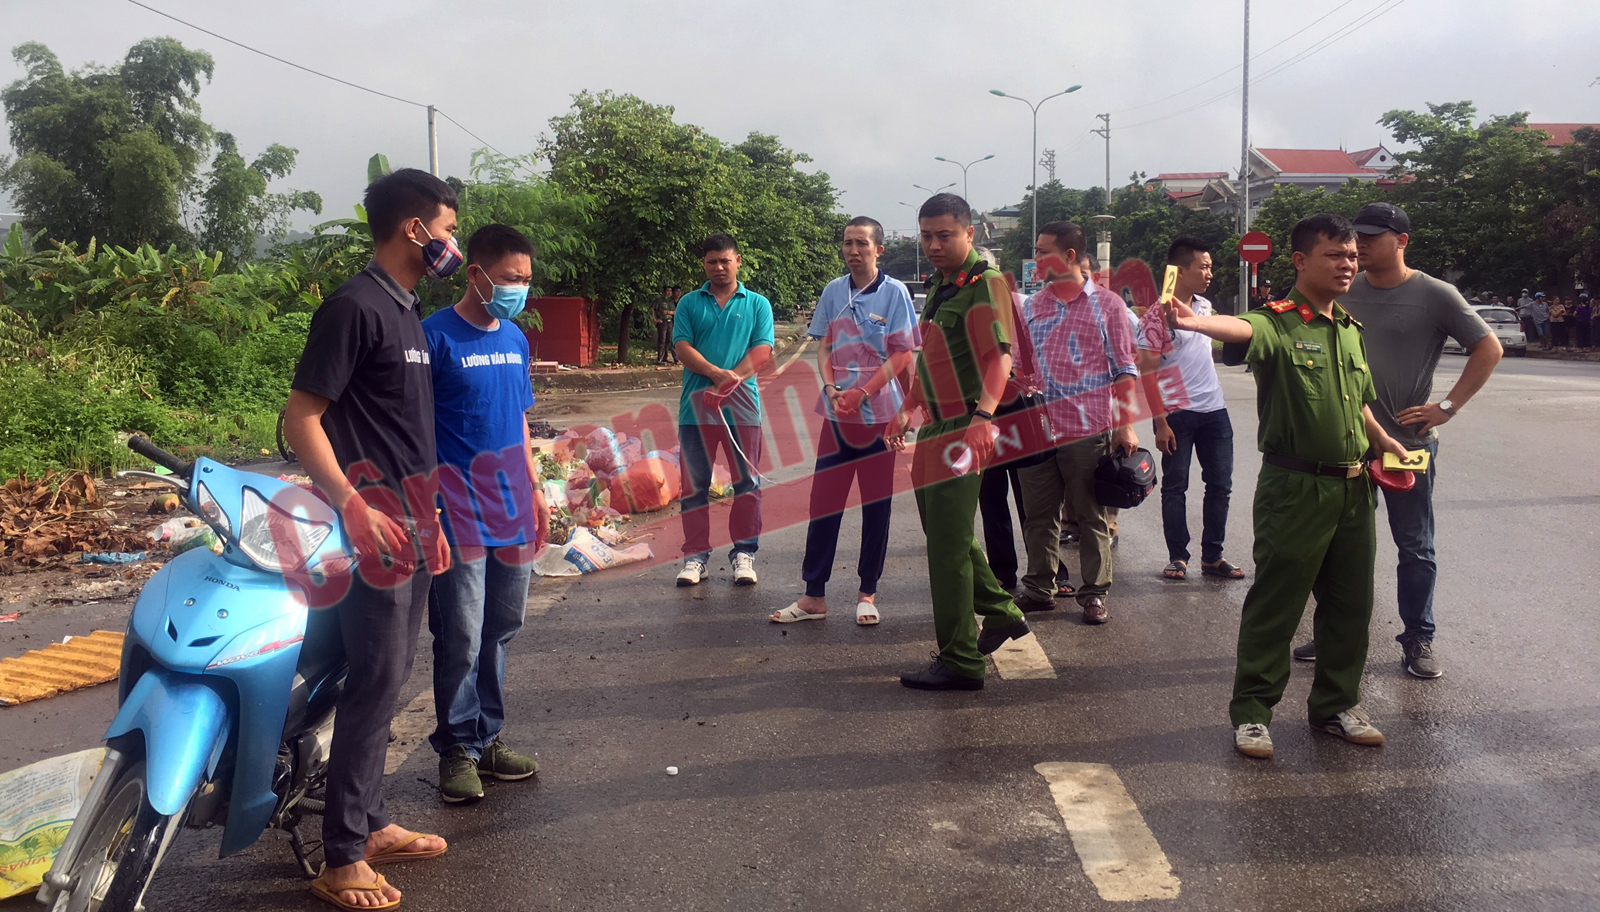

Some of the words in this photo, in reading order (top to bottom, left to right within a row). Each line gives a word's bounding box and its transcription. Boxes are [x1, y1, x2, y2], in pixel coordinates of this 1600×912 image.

[1165, 271, 1175, 294] 2
[461, 353, 490, 368] LƯỜNG
[490, 351, 506, 365] VĂN
[1399, 455, 1423, 466] 3
[204, 576, 240, 592] HONDA
